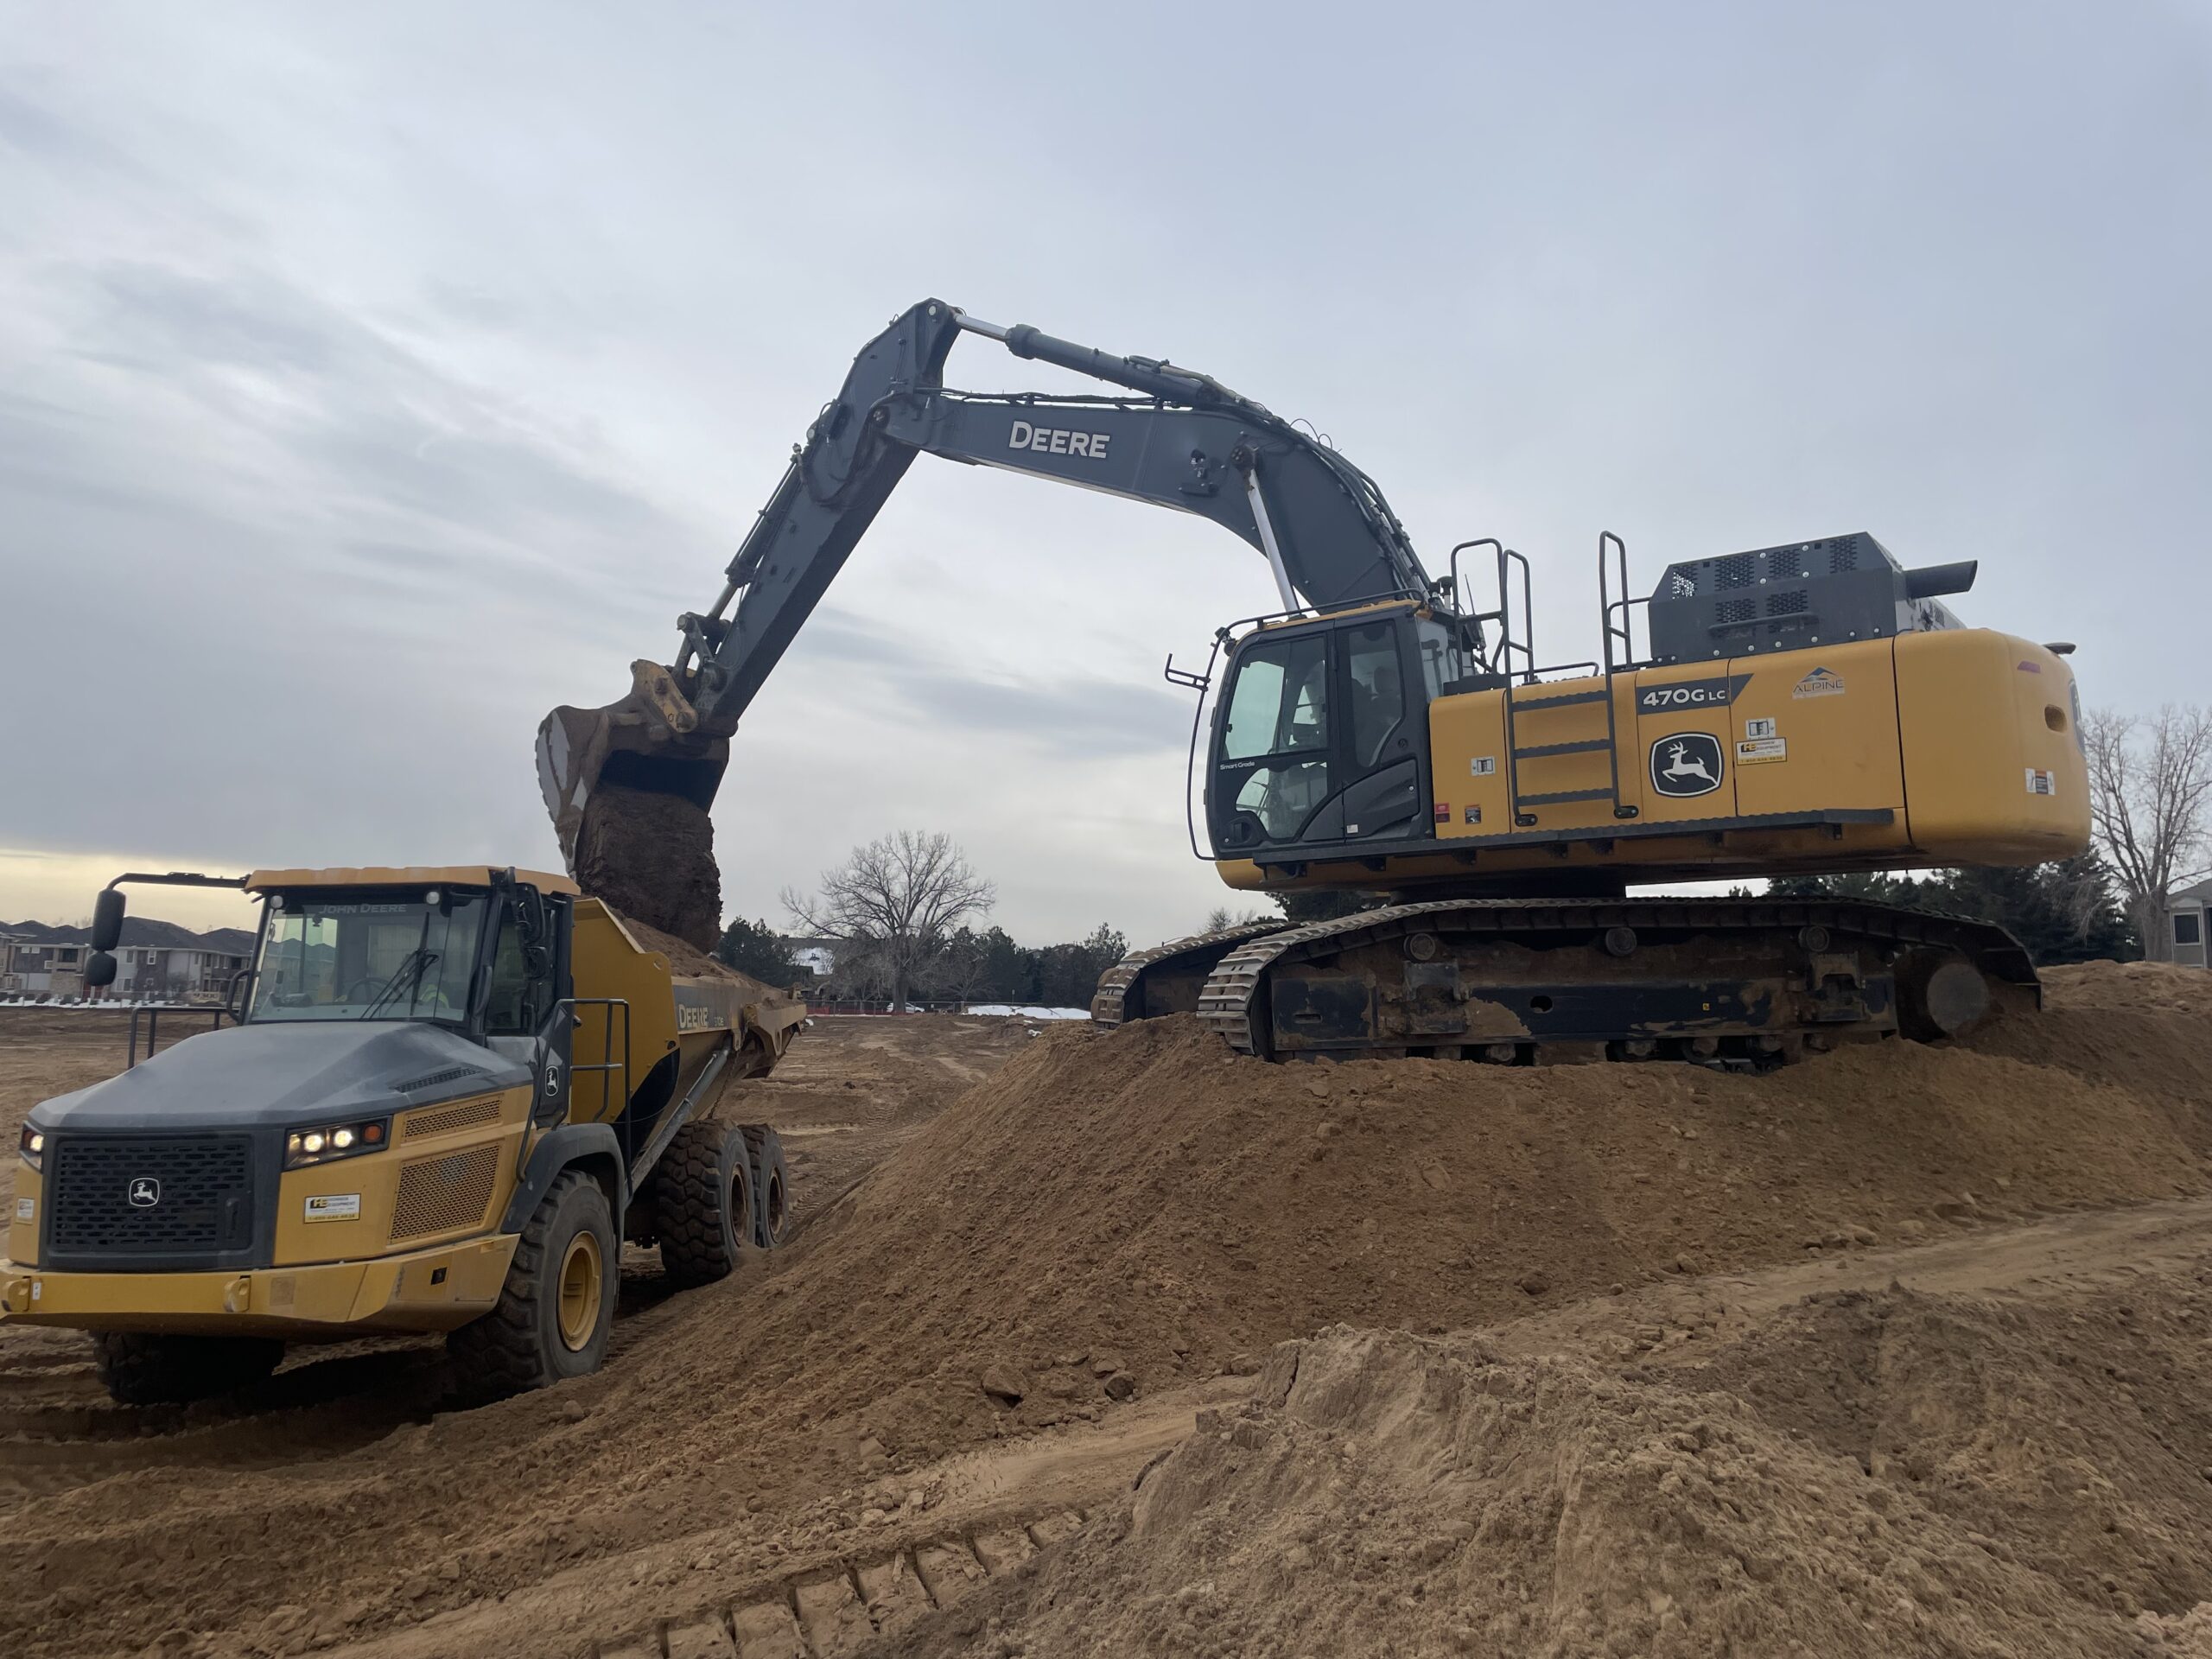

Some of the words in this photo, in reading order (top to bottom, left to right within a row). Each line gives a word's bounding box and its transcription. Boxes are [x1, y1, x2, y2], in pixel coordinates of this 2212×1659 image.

[1008, 420, 1111, 459] DEERE
[1793, 679, 1845, 693] ALPINE
[1643, 688, 1705, 707] 470G
[1708, 690, 1726, 702] LC
[319, 904, 358, 914] JOHN
[359, 903, 408, 913] DEERE
[678, 1003, 709, 1029] DEERE
